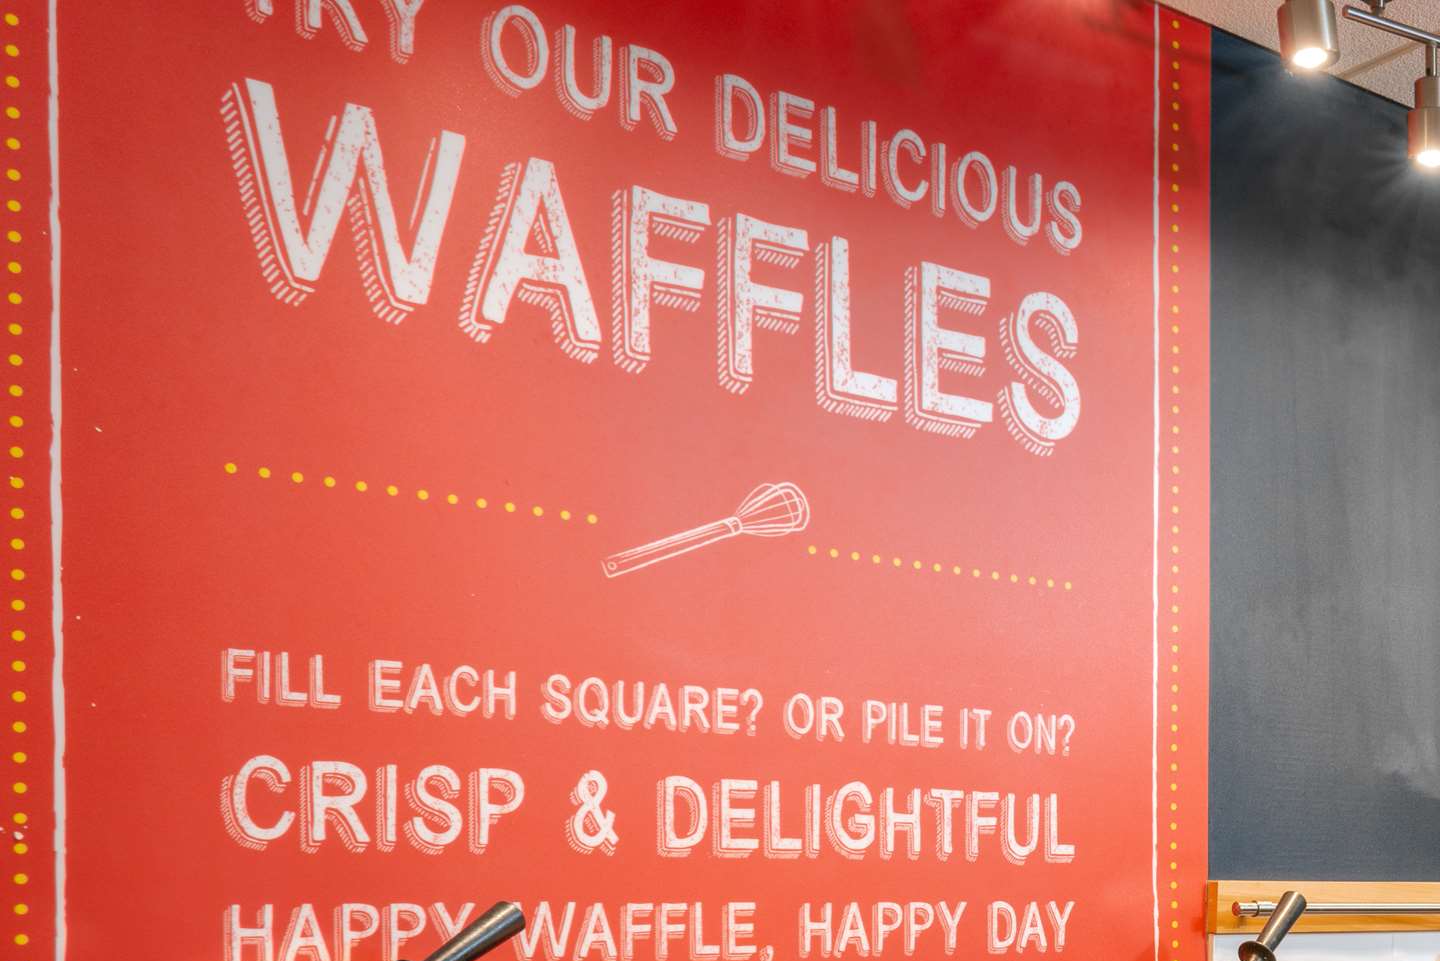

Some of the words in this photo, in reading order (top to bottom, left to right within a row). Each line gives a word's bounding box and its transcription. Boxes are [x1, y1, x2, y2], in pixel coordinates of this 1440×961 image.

[480, 4, 678, 141] OUR
[715, 74, 1082, 254] DELICIOUS
[220, 77, 1080, 457] WAFFLES
[221, 648, 341, 709] FILL
[368, 659, 517, 719] EACH
[540, 674, 763, 736] SQUARE?
[784, 693, 845, 743] OR
[862, 699, 944, 748] PILE
[960, 708, 992, 750] IT
[1007, 711, 1076, 757] ON?
[220, 754, 525, 856] CRISP
[565, 769, 619, 857] &
[656, 775, 1076, 866] DELIGHTFUL
[800, 901, 967, 957] HAPPY
[987, 901, 1075, 955] DAY
